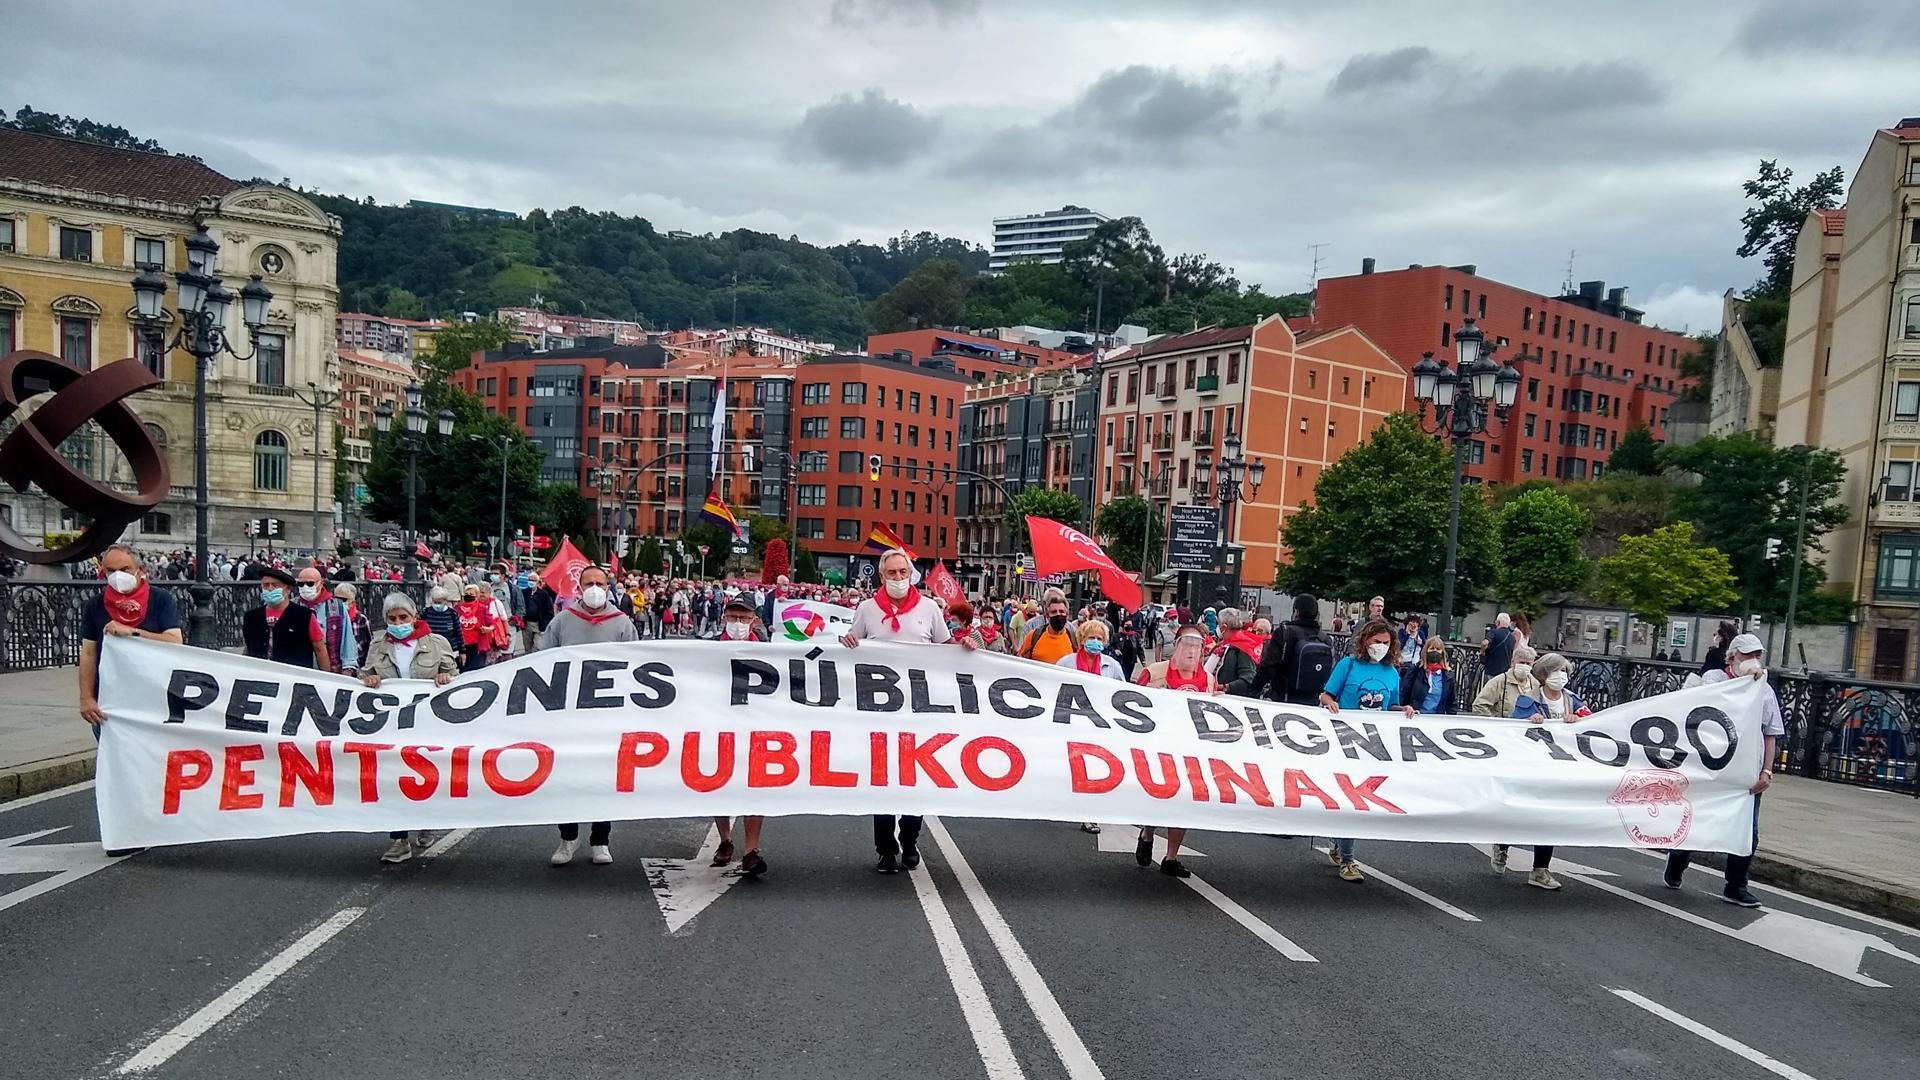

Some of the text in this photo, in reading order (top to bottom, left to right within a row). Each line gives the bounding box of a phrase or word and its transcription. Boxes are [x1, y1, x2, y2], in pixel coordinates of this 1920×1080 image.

[164, 646, 1739, 771] PENSIONES PÚBLICAS DIGNAS 1080
[162, 731, 1407, 815] PENTSIO PUBLIKO DUINAK
